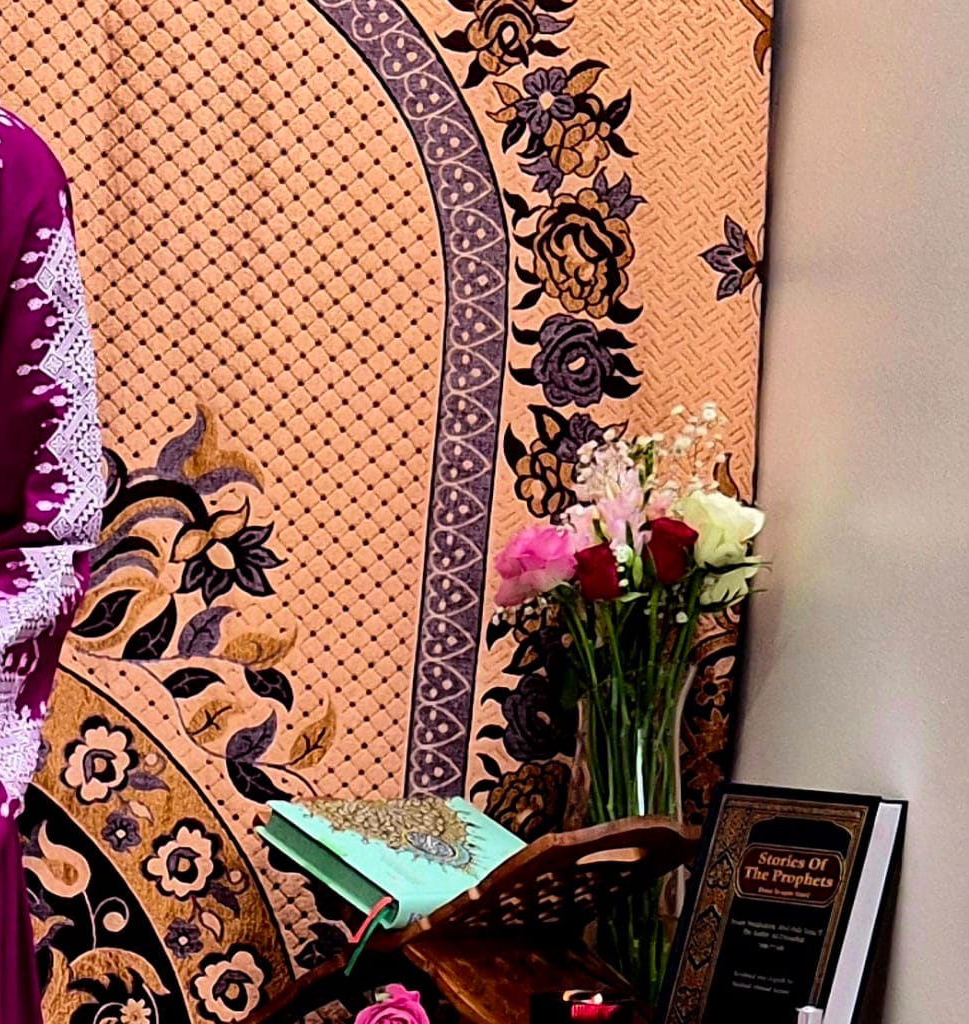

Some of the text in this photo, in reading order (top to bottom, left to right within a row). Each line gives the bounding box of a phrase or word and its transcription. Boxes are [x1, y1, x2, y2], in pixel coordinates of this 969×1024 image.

[758, 852, 828, 871] Stories Of
[744, 866, 834, 888] The Prophets
